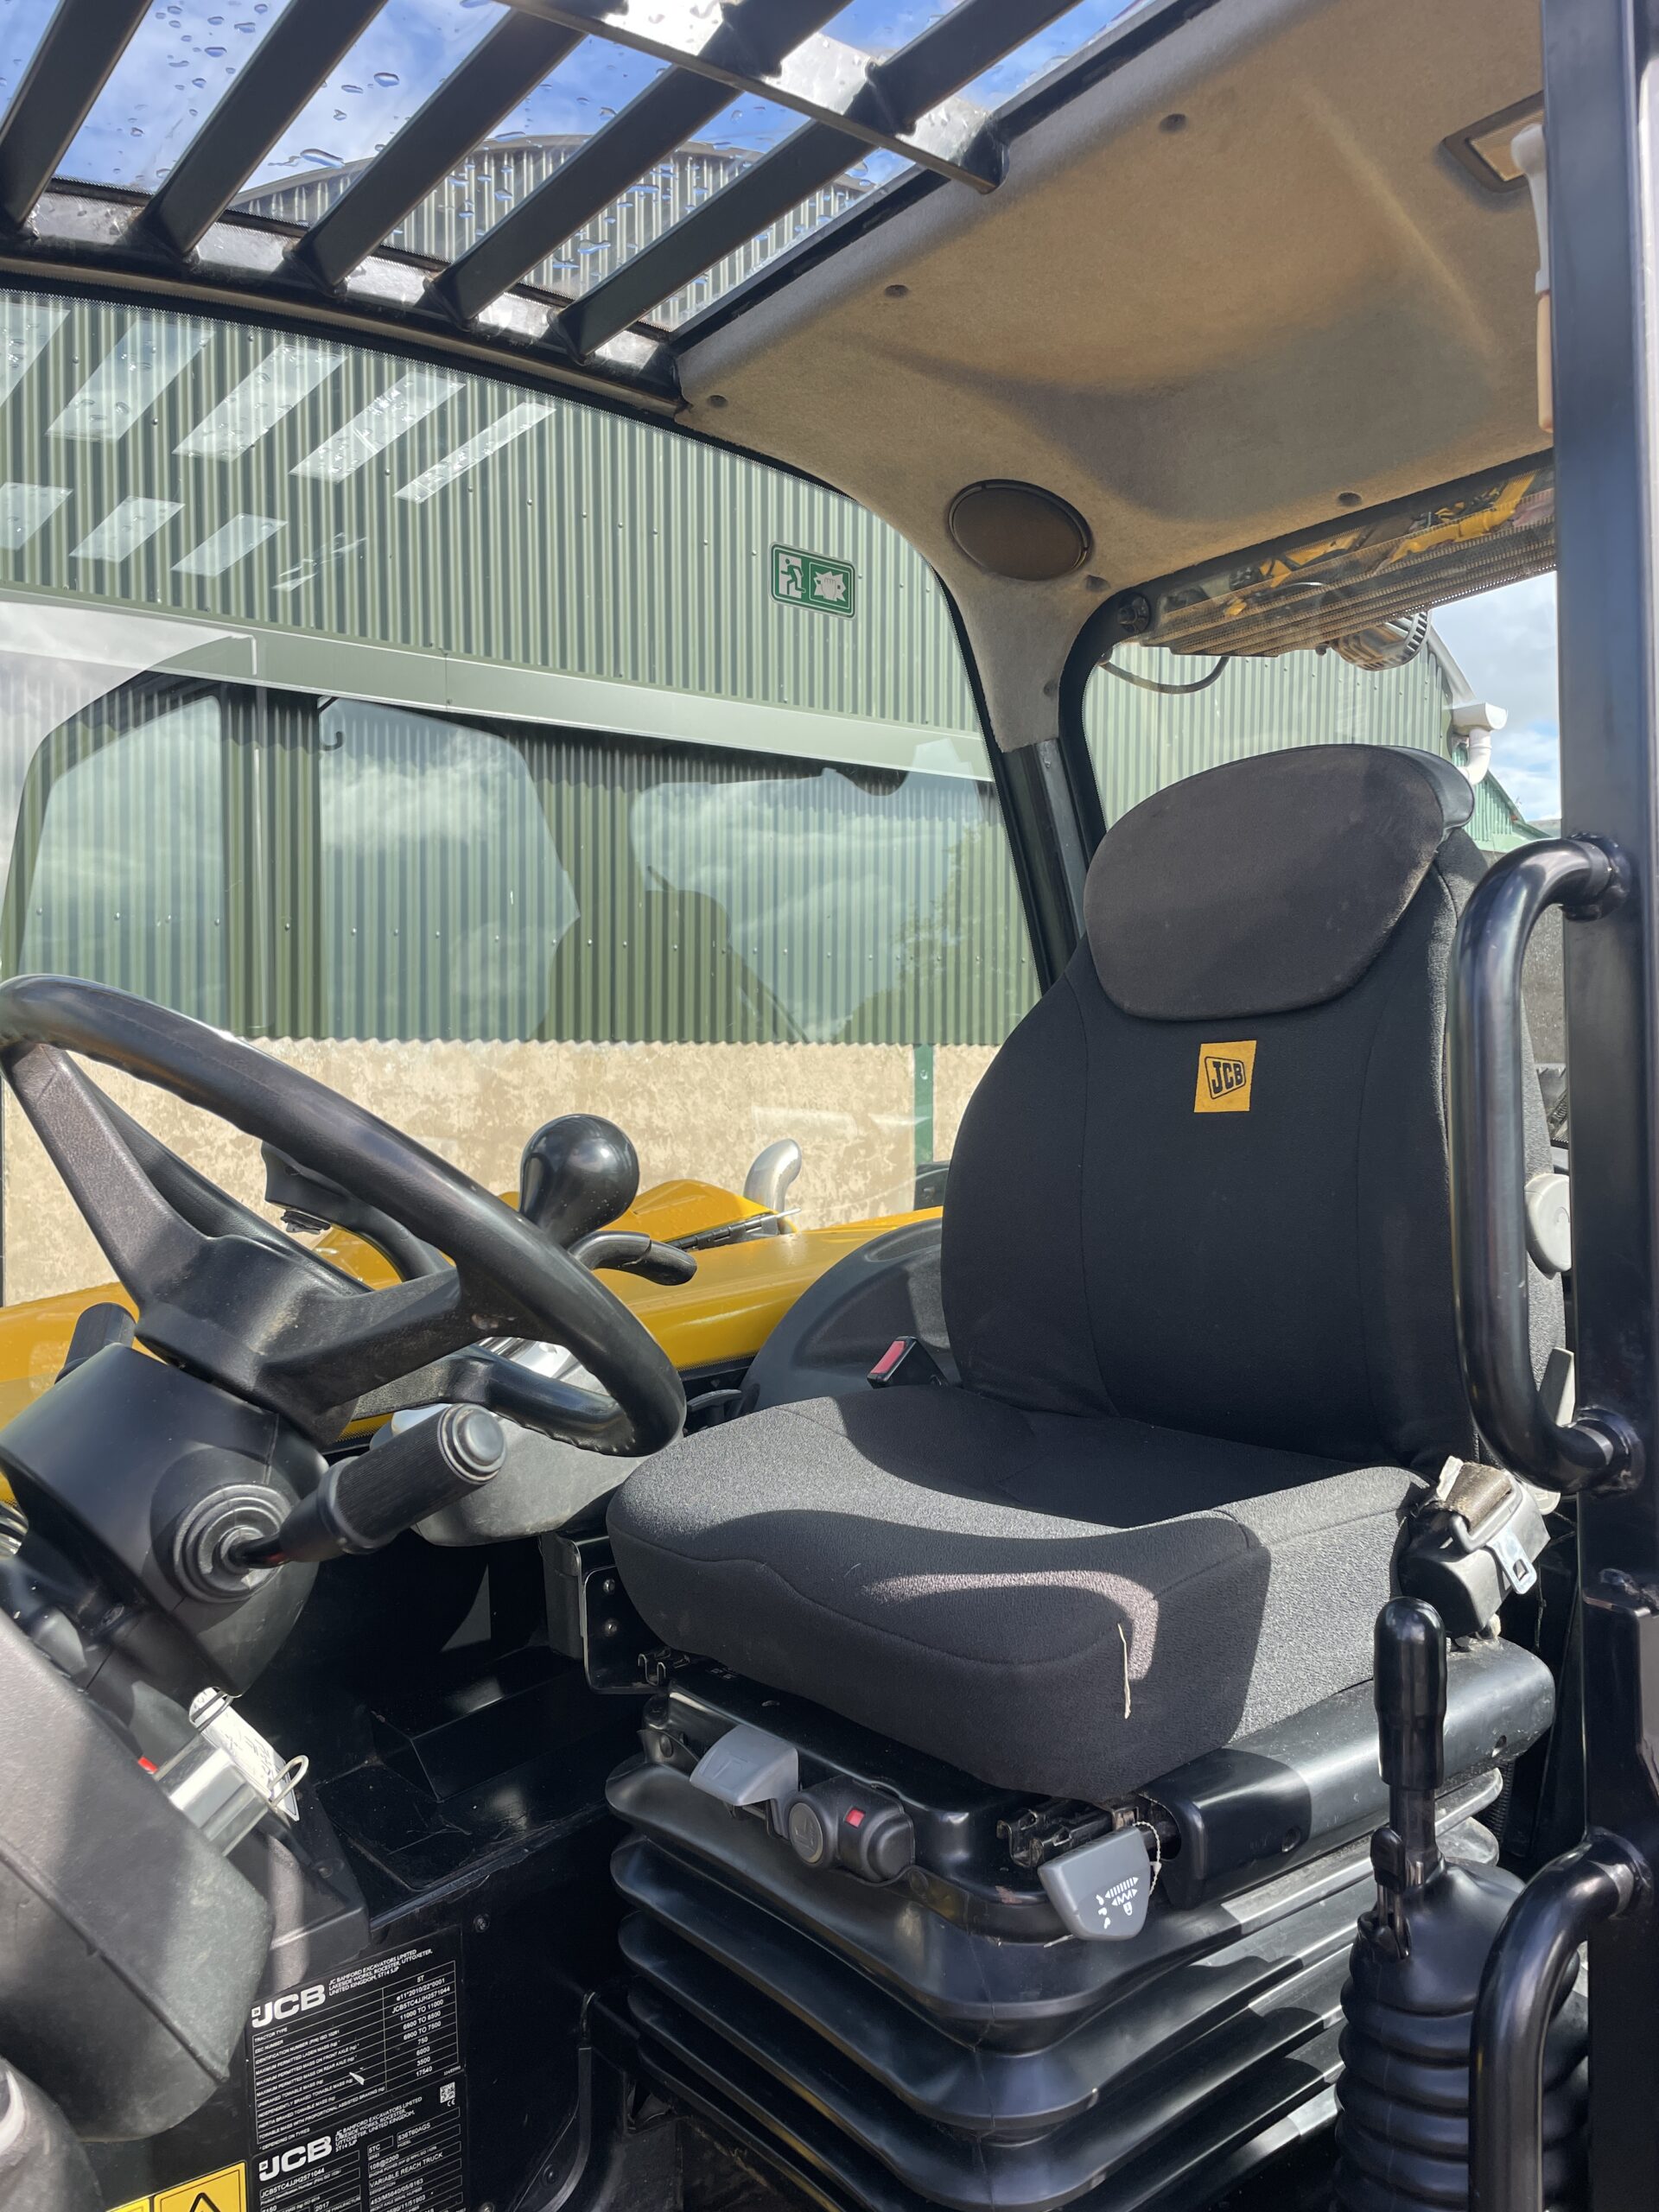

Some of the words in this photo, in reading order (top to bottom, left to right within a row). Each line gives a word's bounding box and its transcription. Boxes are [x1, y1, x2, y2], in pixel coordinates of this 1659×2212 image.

[1211, 1061, 1243, 1094] JCB
[337, 1969, 362, 1983] BAMFORD
[363, 1957, 396, 1974] EXCAVATORS
[397, 1949, 416, 1961] LIMITED
[329, 1979, 353, 1991] LAKESIDE
[329, 1985, 349, 1997] UNITED
[251, 1984, 326, 2028] JCB
[400, 2010, 416, 2021] 11000
[428, 1999, 443, 2011] 11000
[404, 2020, 416, 2030] 6900
[404, 2030, 417, 2041] 6900
[418, 2026, 427, 2035] TO
[429, 2021, 442, 2031] 7500
[255, 2031, 276, 2044] TRACTOR
[276, 2027, 288, 2036] TYPE
[418, 2037, 428, 2045] 750
[256, 2049, 289, 2065] IDENTIFICATION
[290, 2042, 308, 2052] NUMBER
[264, 2040, 283, 2050] NUMBER
[416, 2046, 430, 2056] 6000
[256, 2064, 276, 2075] MAXIMUM
[277, 2055, 302, 2068] PERMITTED
[256, 2075, 277, 2087] MAXIMUM
[278, 2065, 302, 2078] PERMITTED
[323, 2051, 337, 2061] FRONT
[417, 2056, 430, 2067] 3500
[416, 2066, 433, 2077] 17540
[257, 2086, 277, 2098] MAXIMUM
[278, 2076, 302, 2089] PERMITTED
[303, 2082, 315, 2090] MASS
[343, 2119, 368, 2133] BAMFORD
[369, 2105, 402, 2123] EXCAVATORS
[403, 2096, 422, 2108] LIMITED
[369, 2121, 388, 2133] UNITED
[369, 2144, 380, 2153] 5TC
[259, 2136, 332, 2181] JCB
[370, 2171, 399, 2189] VARIABLE
[400, 2161, 422, 2175] REACH
[423, 2152, 442, 2165] TRUCK
[315, 2202, 329, 2212] 2017
